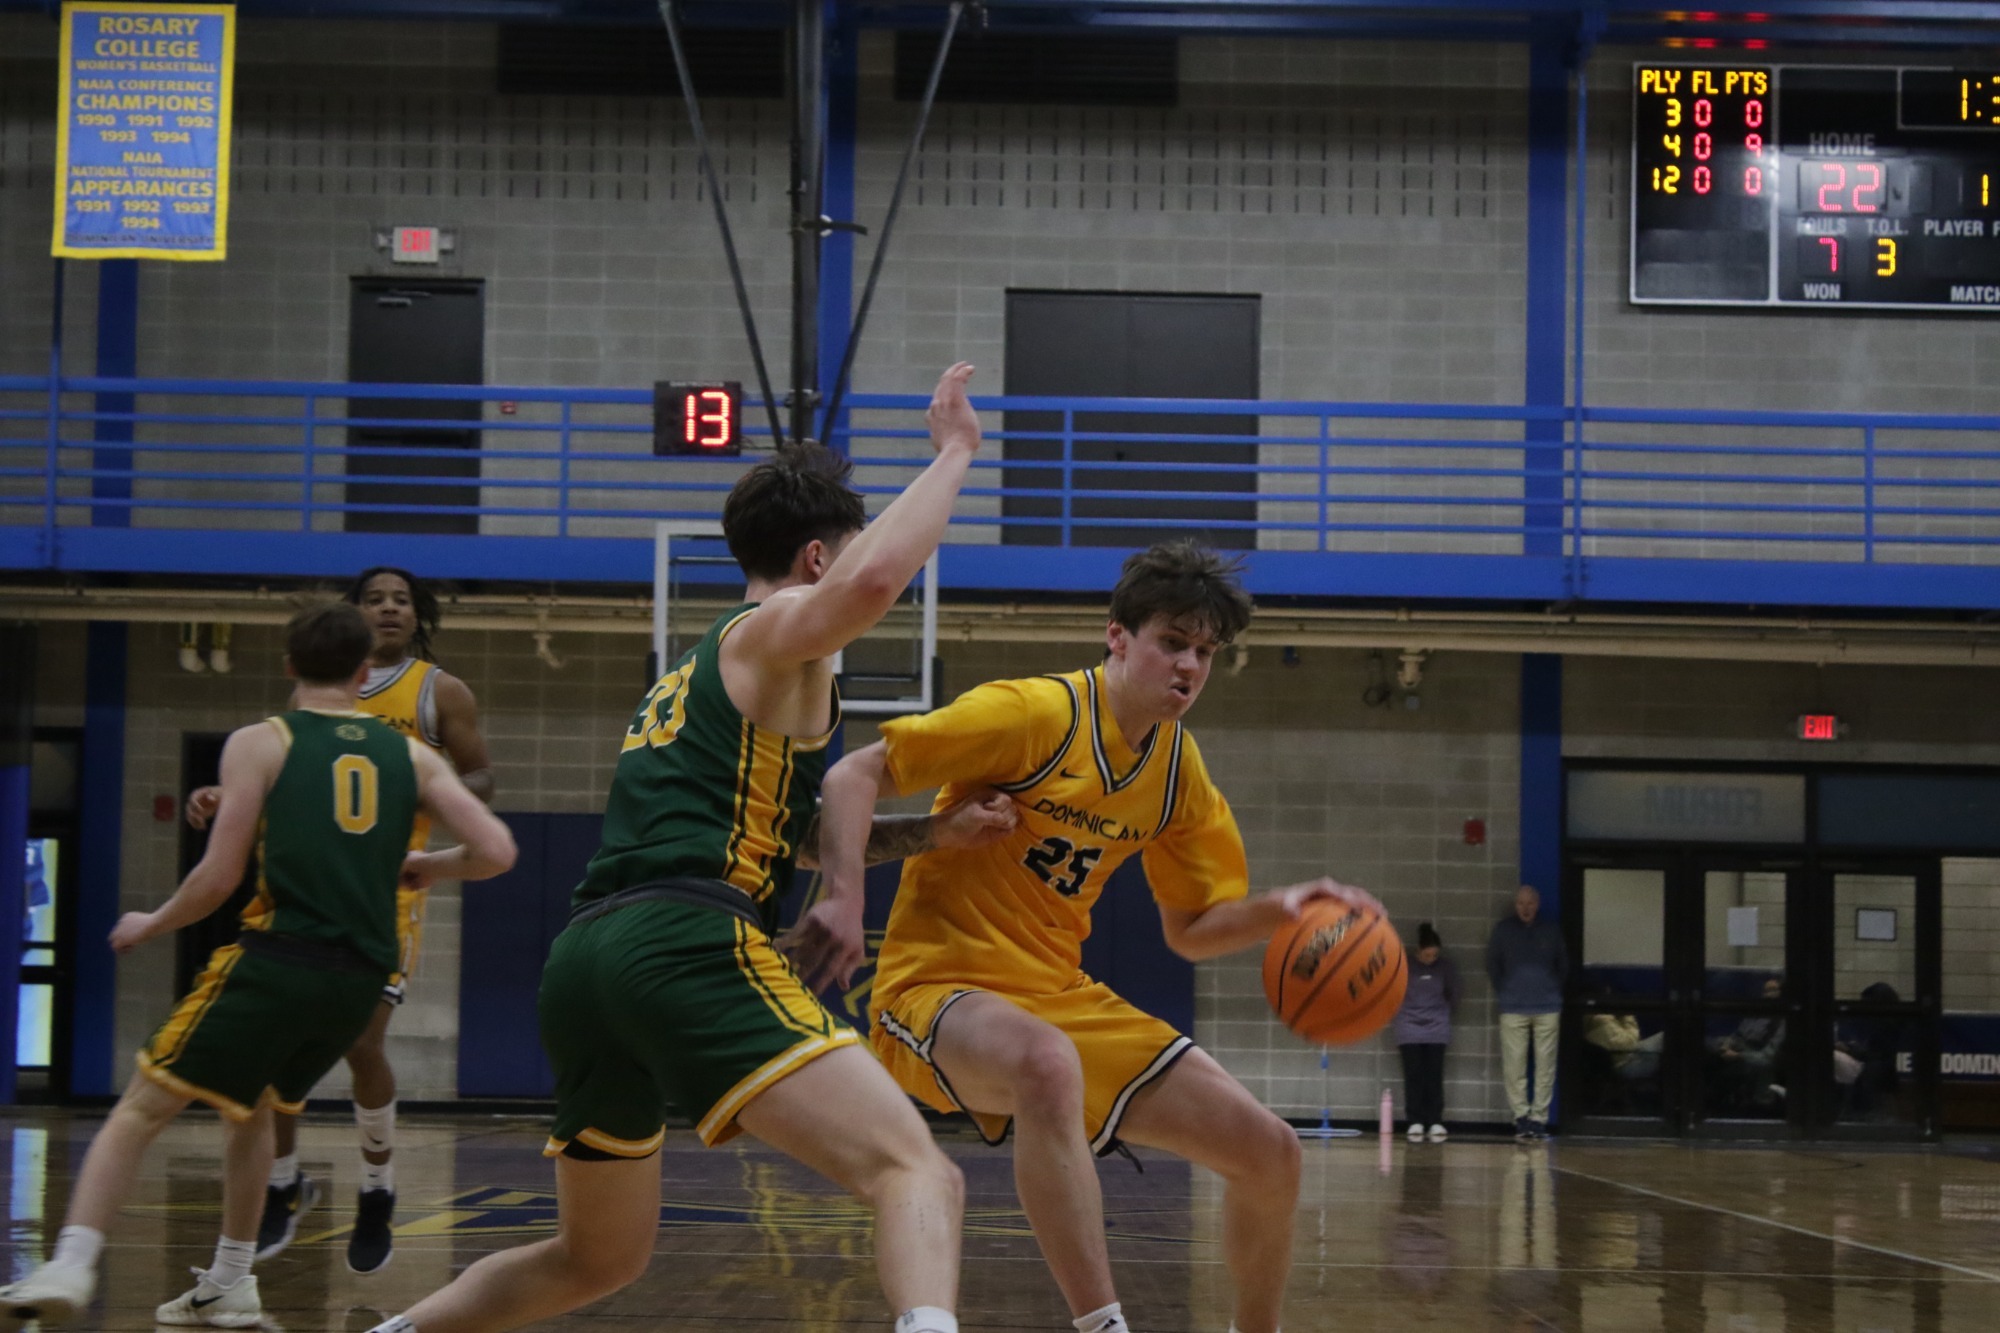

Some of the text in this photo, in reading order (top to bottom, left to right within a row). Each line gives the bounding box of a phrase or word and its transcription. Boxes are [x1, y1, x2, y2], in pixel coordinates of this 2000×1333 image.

[99, 16, 200, 35] ROSARY
[94, 38, 200, 58] COLLEGE
[76, 60, 216, 73] WOMEN'S BASKETBALL
[77, 79, 214, 92] NAIA CONFERENCE
[1641, 69, 1767, 95] PLY FL PTS
[76, 93, 214, 112] CHAMPIONS
[77, 114, 214, 128] 1990 1991 1992
[1666, 98, 1762, 128] 3 0 0
[100, 130, 190, 143] 1993 1994
[1663, 132, 1762, 160] 4 0 9
[1809, 132, 1876, 155] HOME
[122, 152, 163, 163] NAIA
[70, 166, 213, 178] NATIONAL TOURNAMENT
[1653, 165, 1762, 194] 12 0 0
[70, 180, 214, 197] APPEARANCES
[1818, 163, 1880, 213] 22
[75, 200, 111, 212] 1991
[122, 200, 160, 213] 1992
[121, 217, 160, 228] 1994
[1797, 217, 1847, 235] FOULS
[1923, 219, 1984, 236] PLAYER
[402, 229, 432, 252] EXIT
[1819, 237, 1838, 272] 7
[1877, 238, 1896, 276] 3
[1803, 283, 1841, 299] WON
[686, 391, 730, 446] 13
[1804, 715, 1834, 739] EXIT
[332, 753, 379, 835] 0
[1032, 797, 1150, 842] DOMINICAN
[1021, 836, 1104, 898] 25
